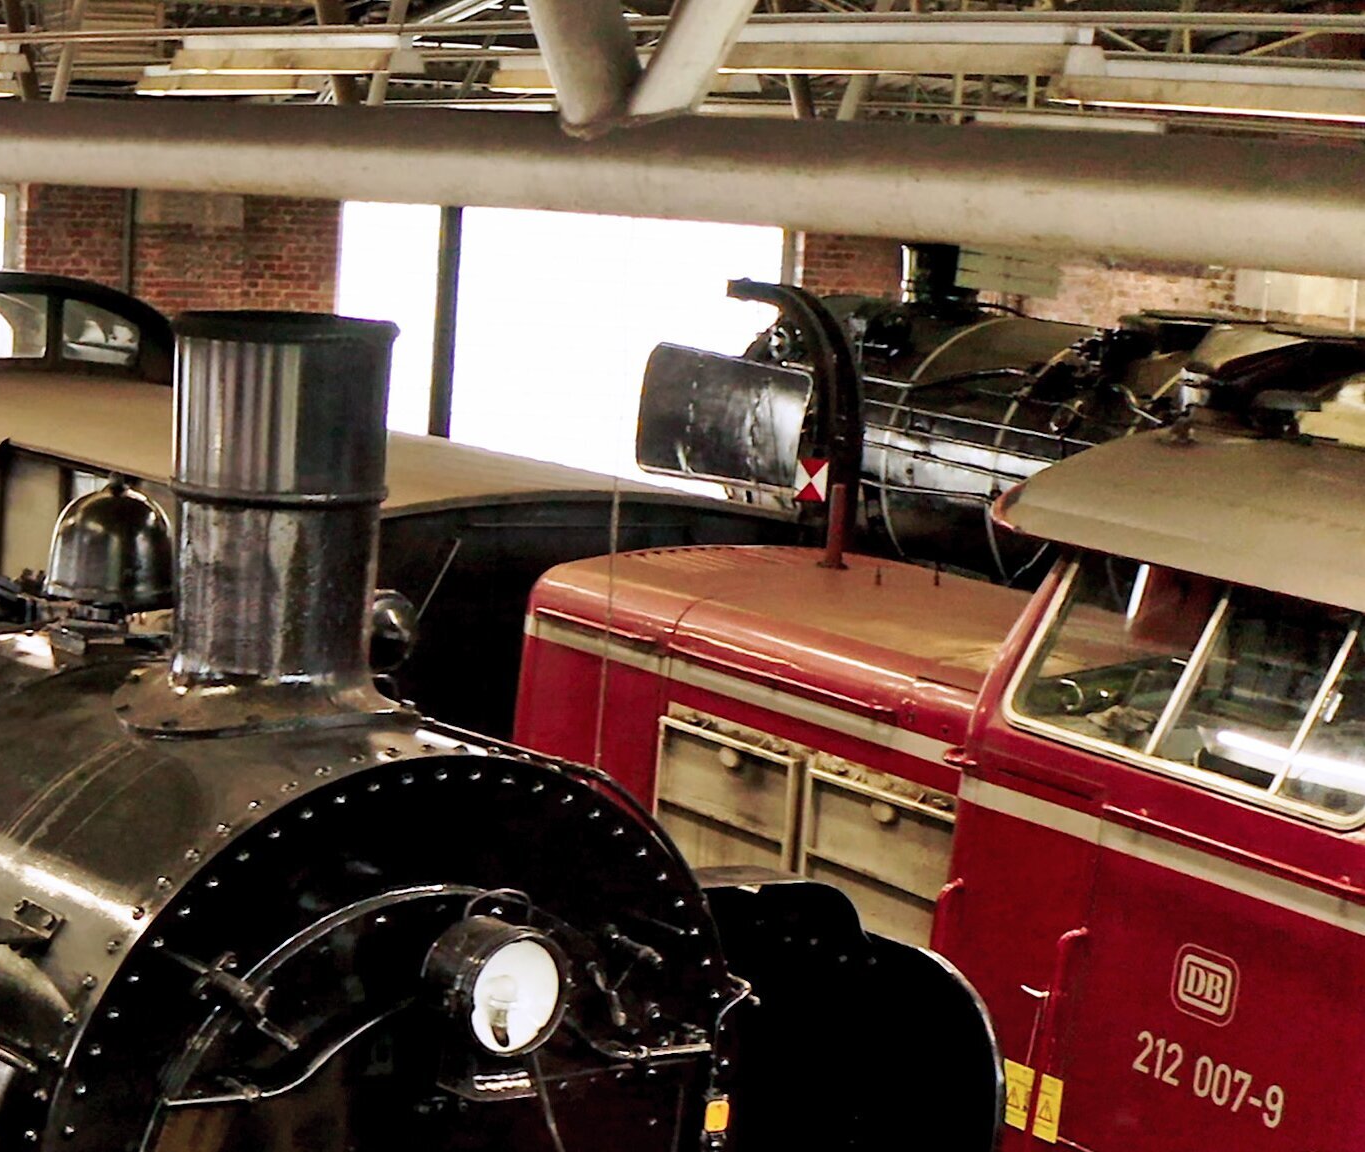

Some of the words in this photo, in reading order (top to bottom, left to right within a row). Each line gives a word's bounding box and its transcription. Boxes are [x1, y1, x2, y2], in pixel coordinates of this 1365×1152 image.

[1184, 964, 1224, 1005] DB
[1132, 1031, 1183, 1087] 212
[1193, 1055, 1285, 1128] 007-9
